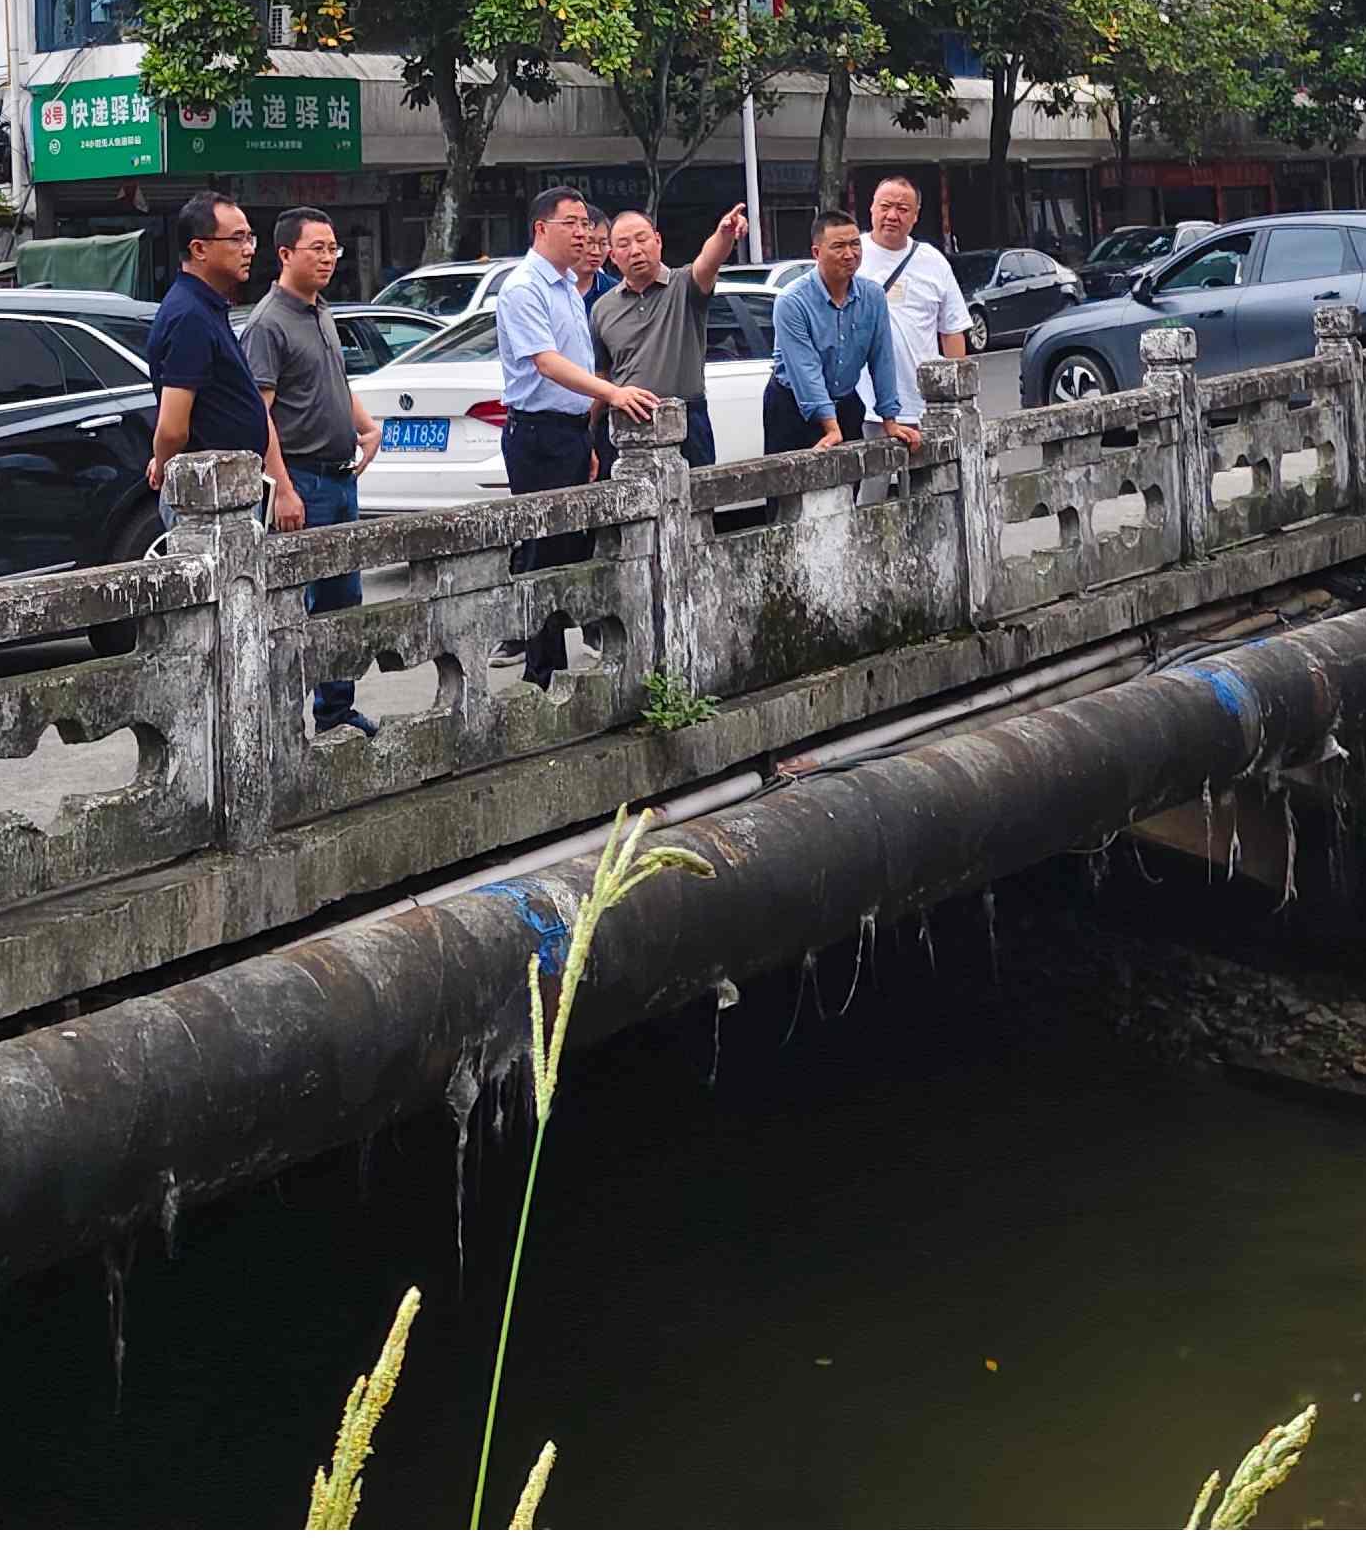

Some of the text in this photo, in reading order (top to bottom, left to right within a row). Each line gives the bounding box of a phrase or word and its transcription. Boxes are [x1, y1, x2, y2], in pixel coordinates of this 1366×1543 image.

[44, 93, 150, 129] 8号 快递驿站
[229, 94, 351, 131] 快递驿站
